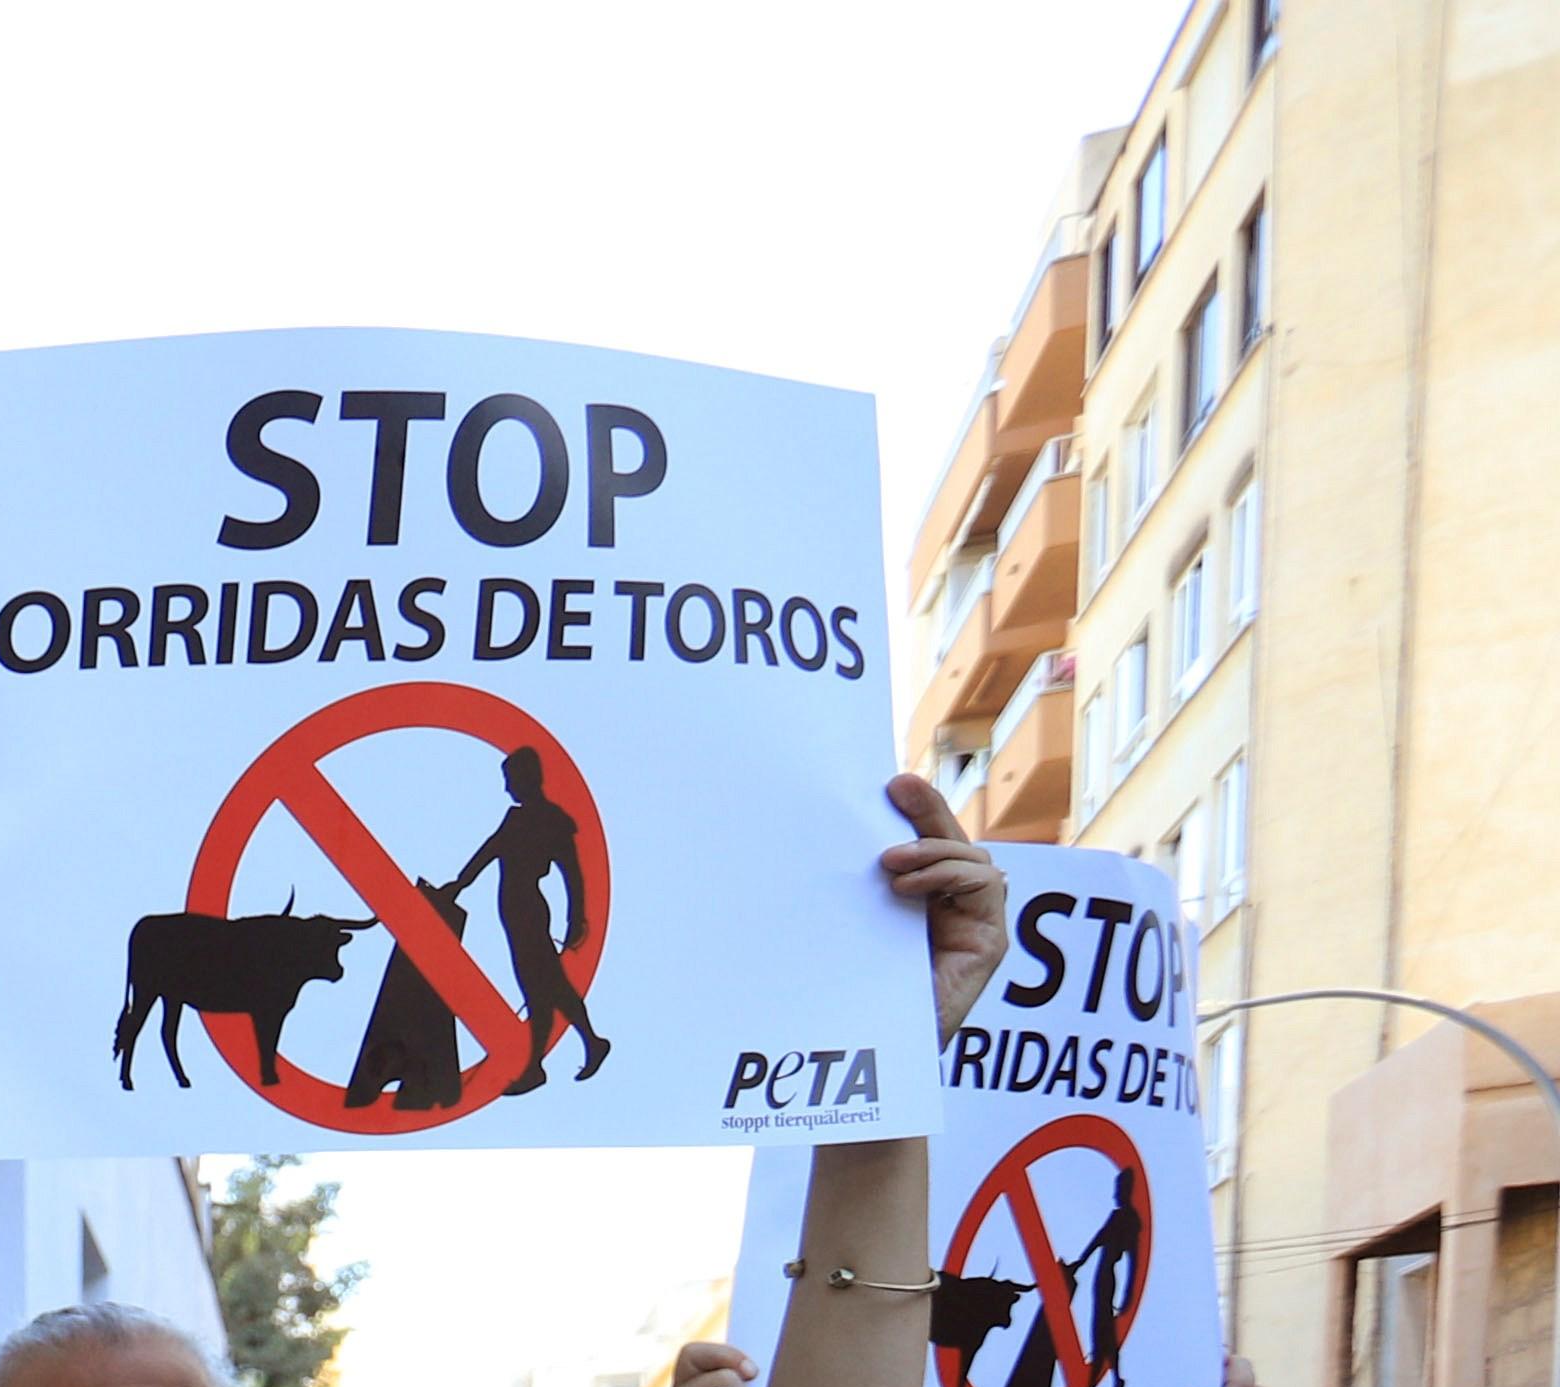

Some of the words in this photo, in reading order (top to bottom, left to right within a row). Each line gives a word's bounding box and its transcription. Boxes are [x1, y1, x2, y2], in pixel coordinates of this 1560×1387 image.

[215, 387, 670, 551] STOP
[471, 577, 595, 661] DE
[613, 580, 866, 681] TOROS
[1001, 891, 1186, 1028] STOP
[721, 1047, 879, 1111] PeTA
[939, 1026, 1115, 1101] RIDAS
[1116, 1042, 1168, 1108] DE
[721, 1112, 772, 1134] stoppt
[774, 1106, 881, 1131] tierquälerei!
